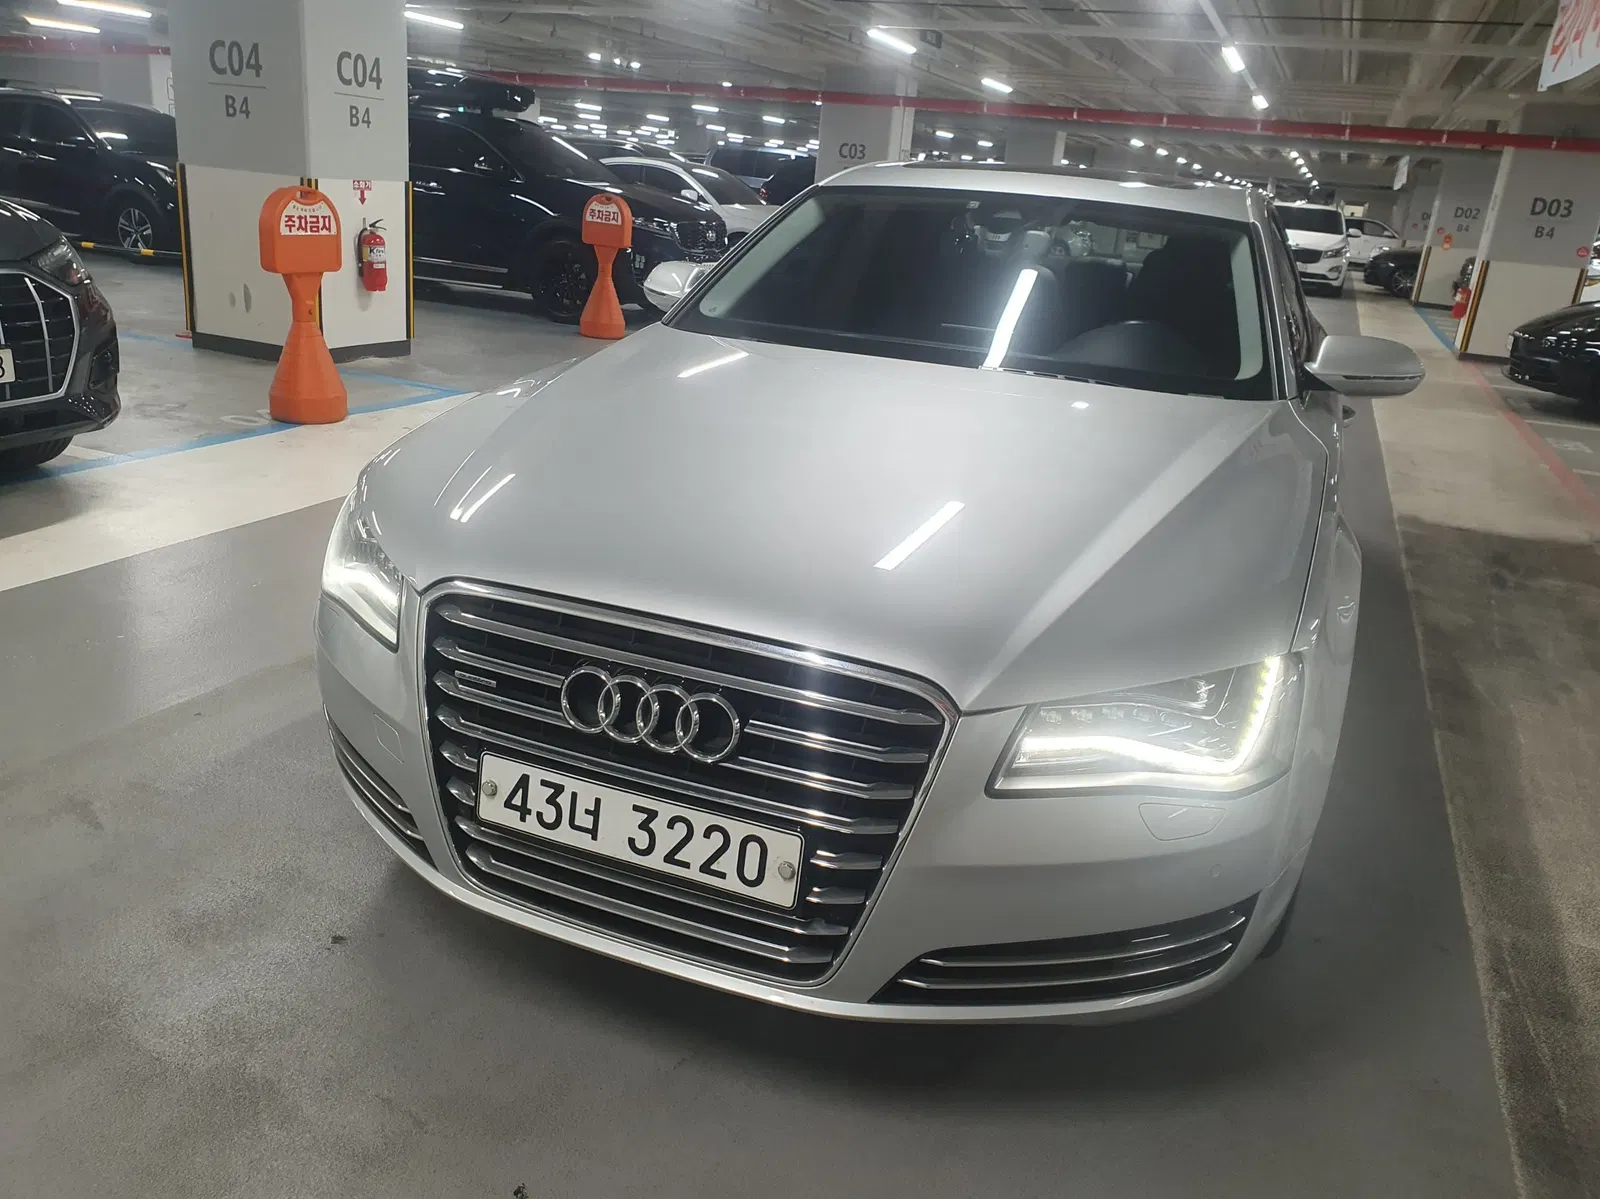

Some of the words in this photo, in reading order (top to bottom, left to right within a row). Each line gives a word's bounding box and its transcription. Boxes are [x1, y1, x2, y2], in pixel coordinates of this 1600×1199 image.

[209, 39, 263, 78] C04
[336, 50, 383, 91] C04
[224, 94, 251, 119] B4
[349, 104, 372, 129] B4
[838, 142, 867, 160] C03
[589, 208, 620, 224] 주차금지
[1453, 206, 1481, 220] D02
[1529, 196, 1575, 219] D03
[284, 214, 332, 234] 주차금지
[1534, 225, 1556, 240] B4
[502, 772, 603, 843] 43너
[627, 803, 769, 889] 3220
